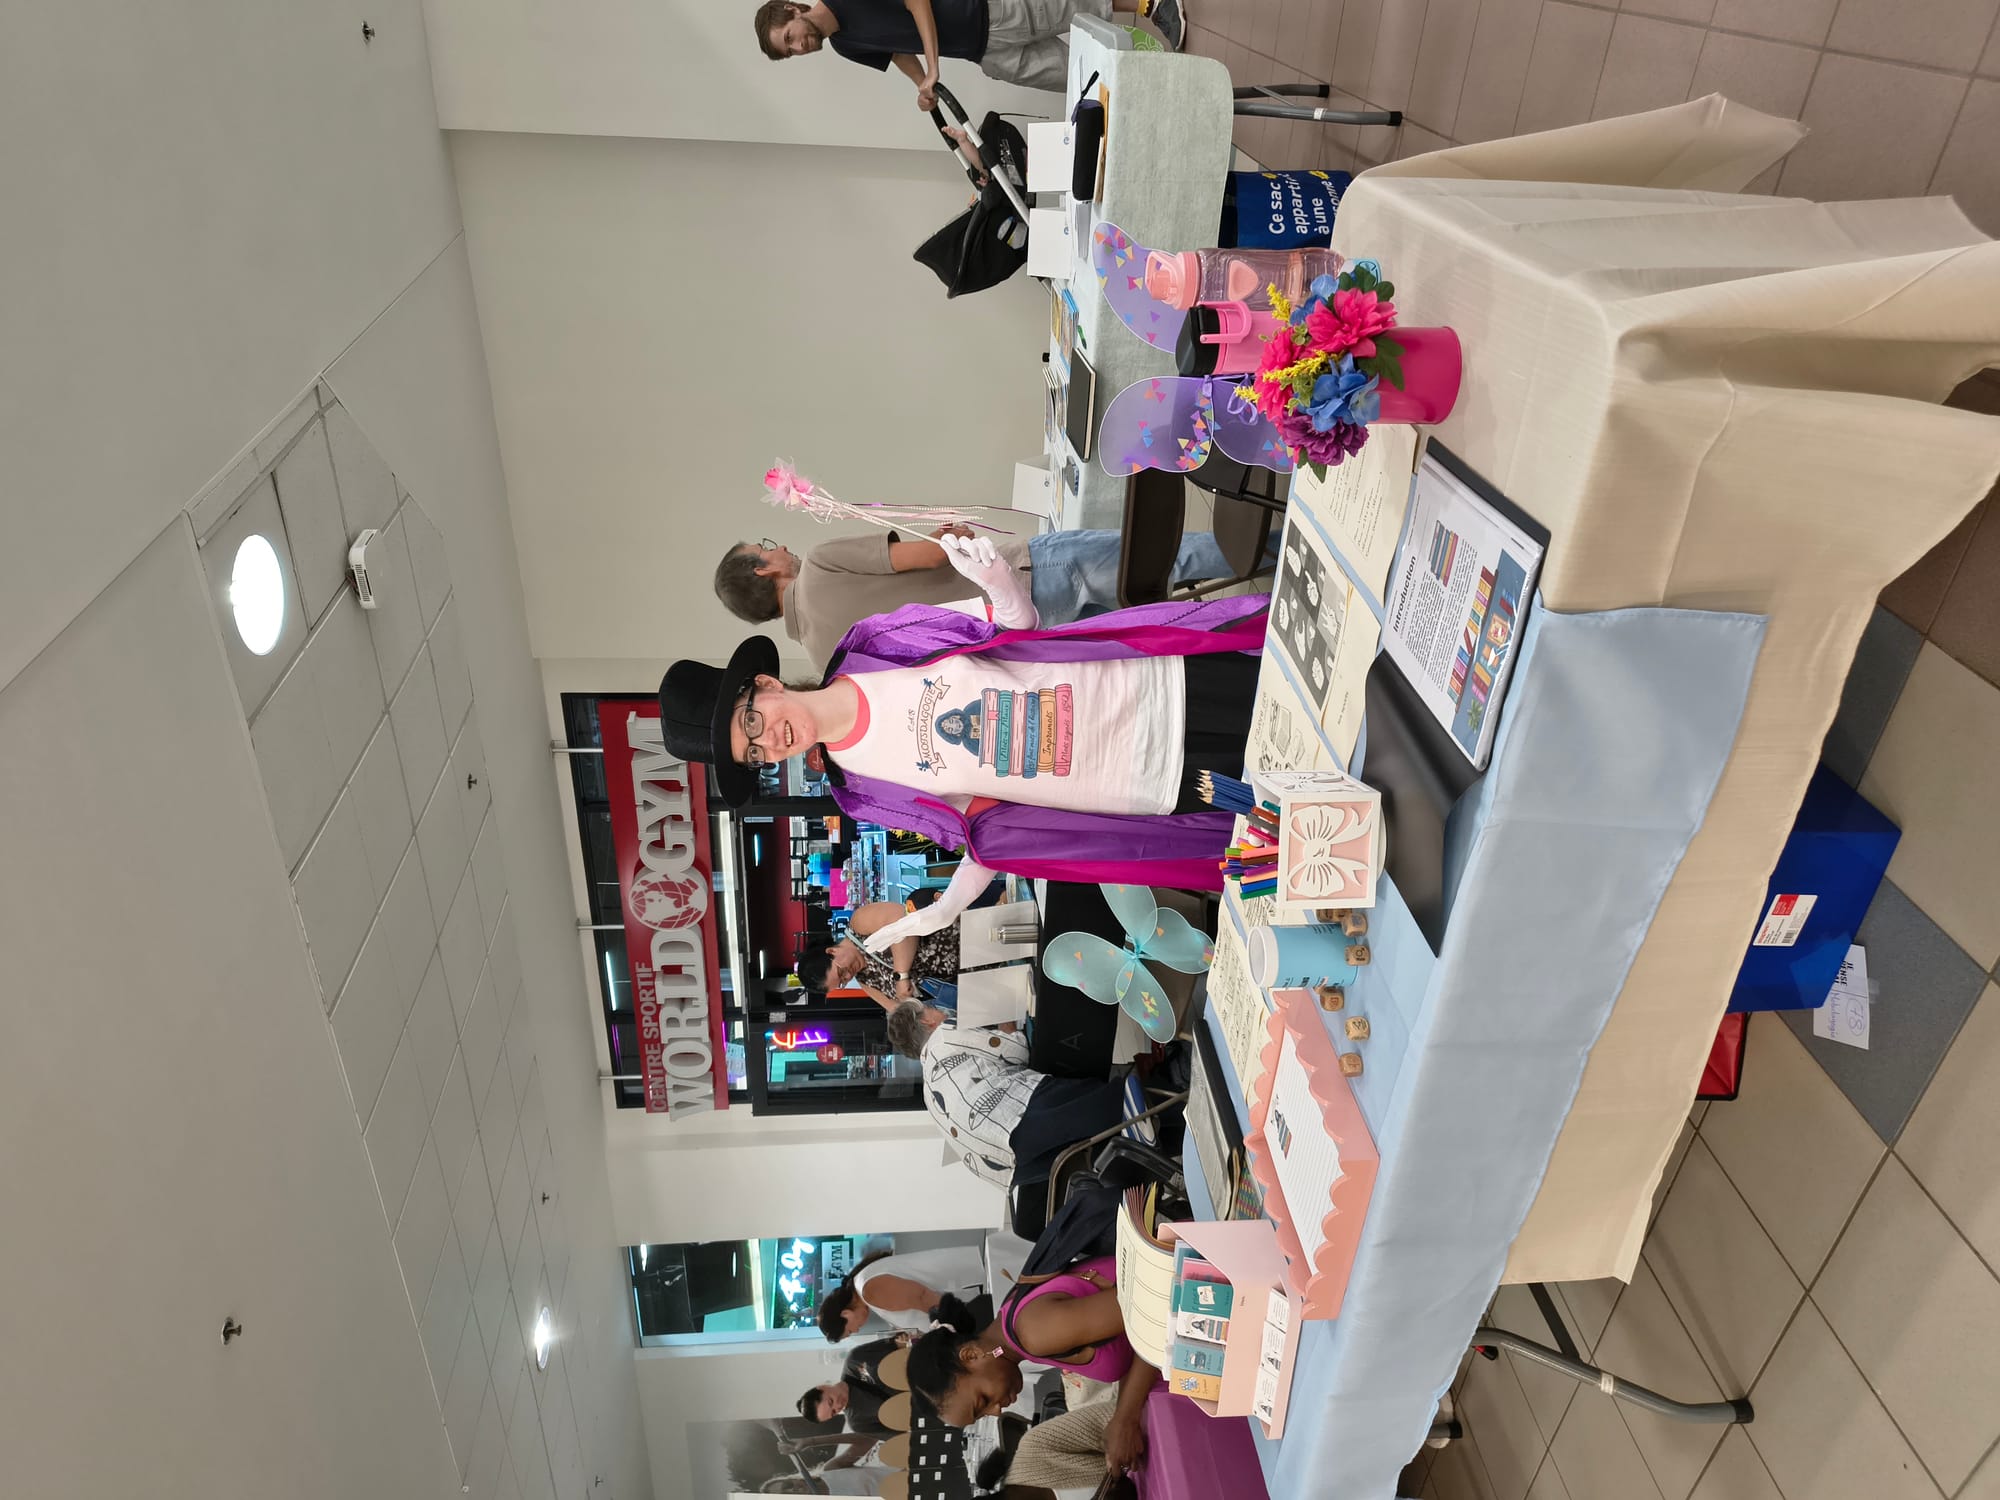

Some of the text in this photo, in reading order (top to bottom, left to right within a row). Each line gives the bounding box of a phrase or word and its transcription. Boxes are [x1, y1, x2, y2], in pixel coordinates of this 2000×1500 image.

[1269, 182, 1285, 234] Ce sac
[1312, 198, 1329, 234] à une
[1393, 555, 1417, 633] Introduction
[626, 711, 715, 1121] WORLD GYM
[635, 962, 667, 1112] CENTRE SPORTIF
